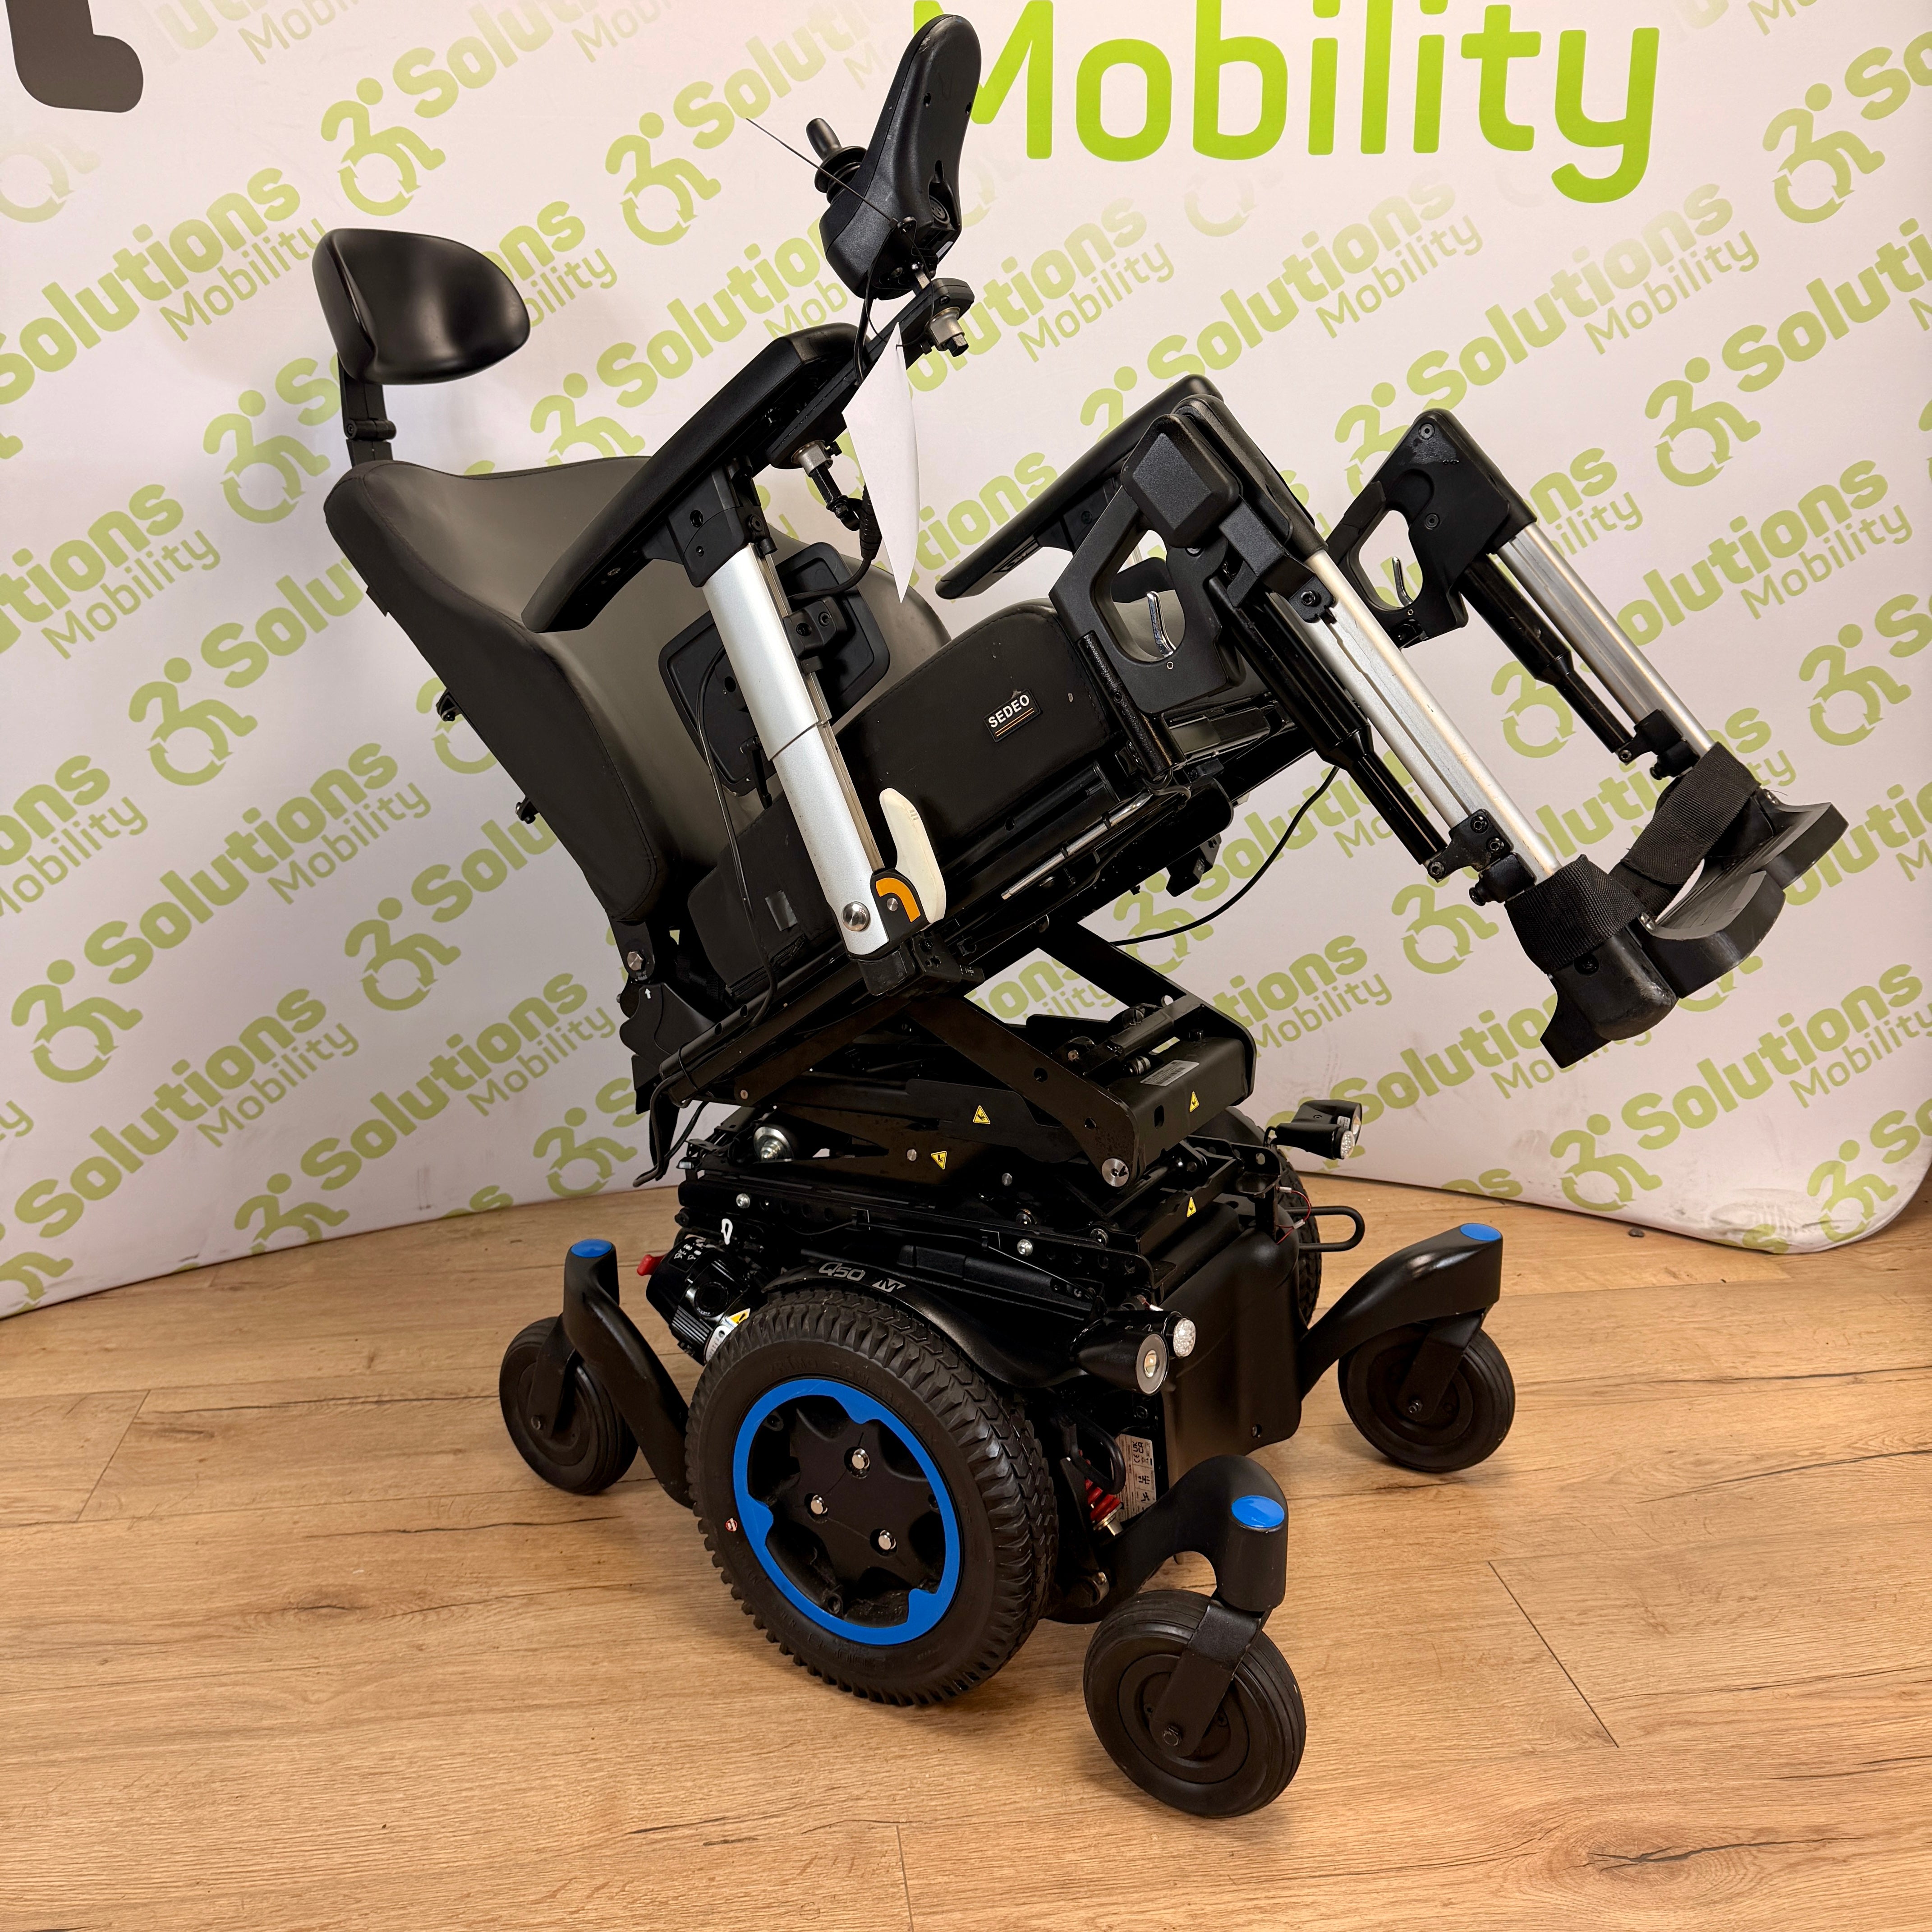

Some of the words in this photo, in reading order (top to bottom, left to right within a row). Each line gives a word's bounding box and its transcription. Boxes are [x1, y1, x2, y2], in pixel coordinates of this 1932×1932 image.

[1017, 243, 1174, 363] Mobility
[1316, 215, 1482, 339] Mobility
[1584, 230, 1759, 354] Mobility
[41, 529, 221, 660] Mobility
[1616, 460, 1888, 645] olutions
[1740, 505, 1913, 620] Mobility
[988, 695, 1029, 727] SEDEO
[84, 743, 398, 984] Solutions
[267, 782, 431, 905] Mobility
[14, 989, 327, 1238] Solutions
[196, 1023, 359, 1148] Mobility
[300, 973, 588, 1190] Solutions
[466, 1007, 616, 1116] Mobility
[1621, 964, 1923, 1150] Solutions
[819, 1262, 866, 1281] Q50
